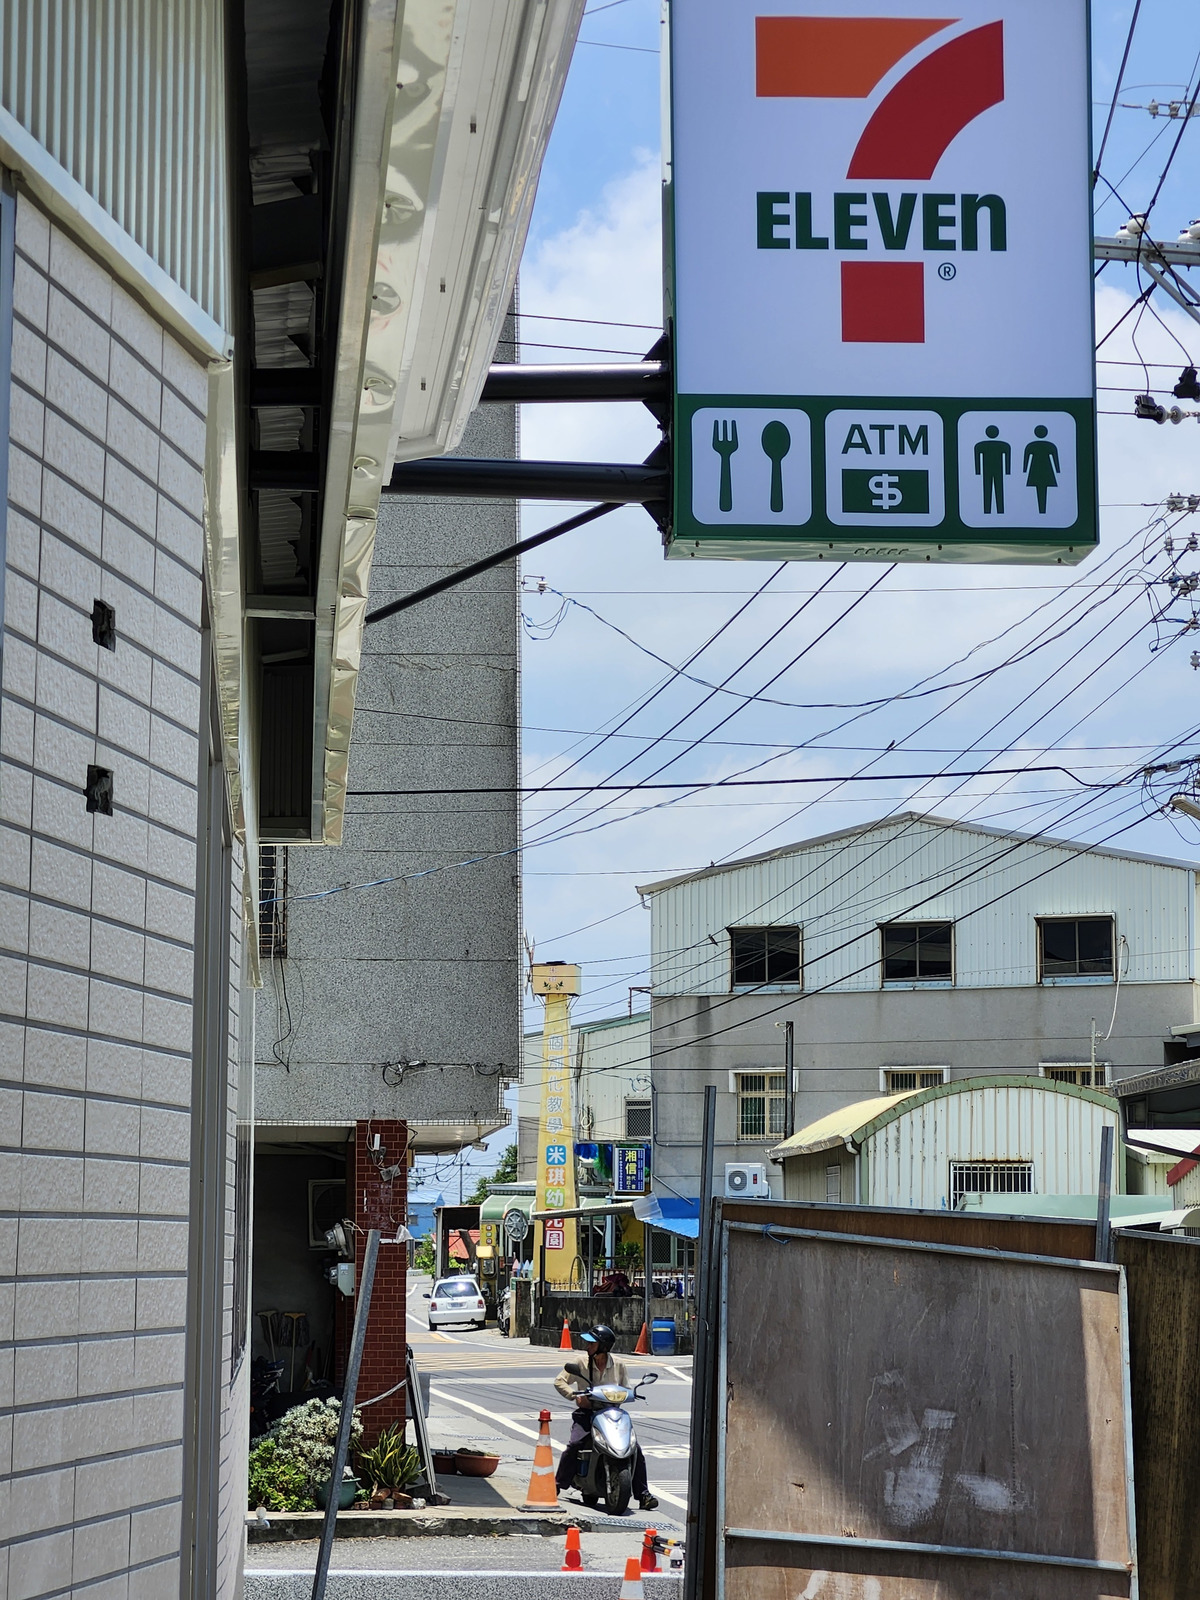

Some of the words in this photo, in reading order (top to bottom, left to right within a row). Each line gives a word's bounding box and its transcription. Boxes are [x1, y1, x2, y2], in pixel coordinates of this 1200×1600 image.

[755, 16, 1005, 343] 7
[756, 191, 1007, 252] ELEVEn
[841, 423, 929, 456] ATM
[625, 1150, 637, 1175] 湘信
